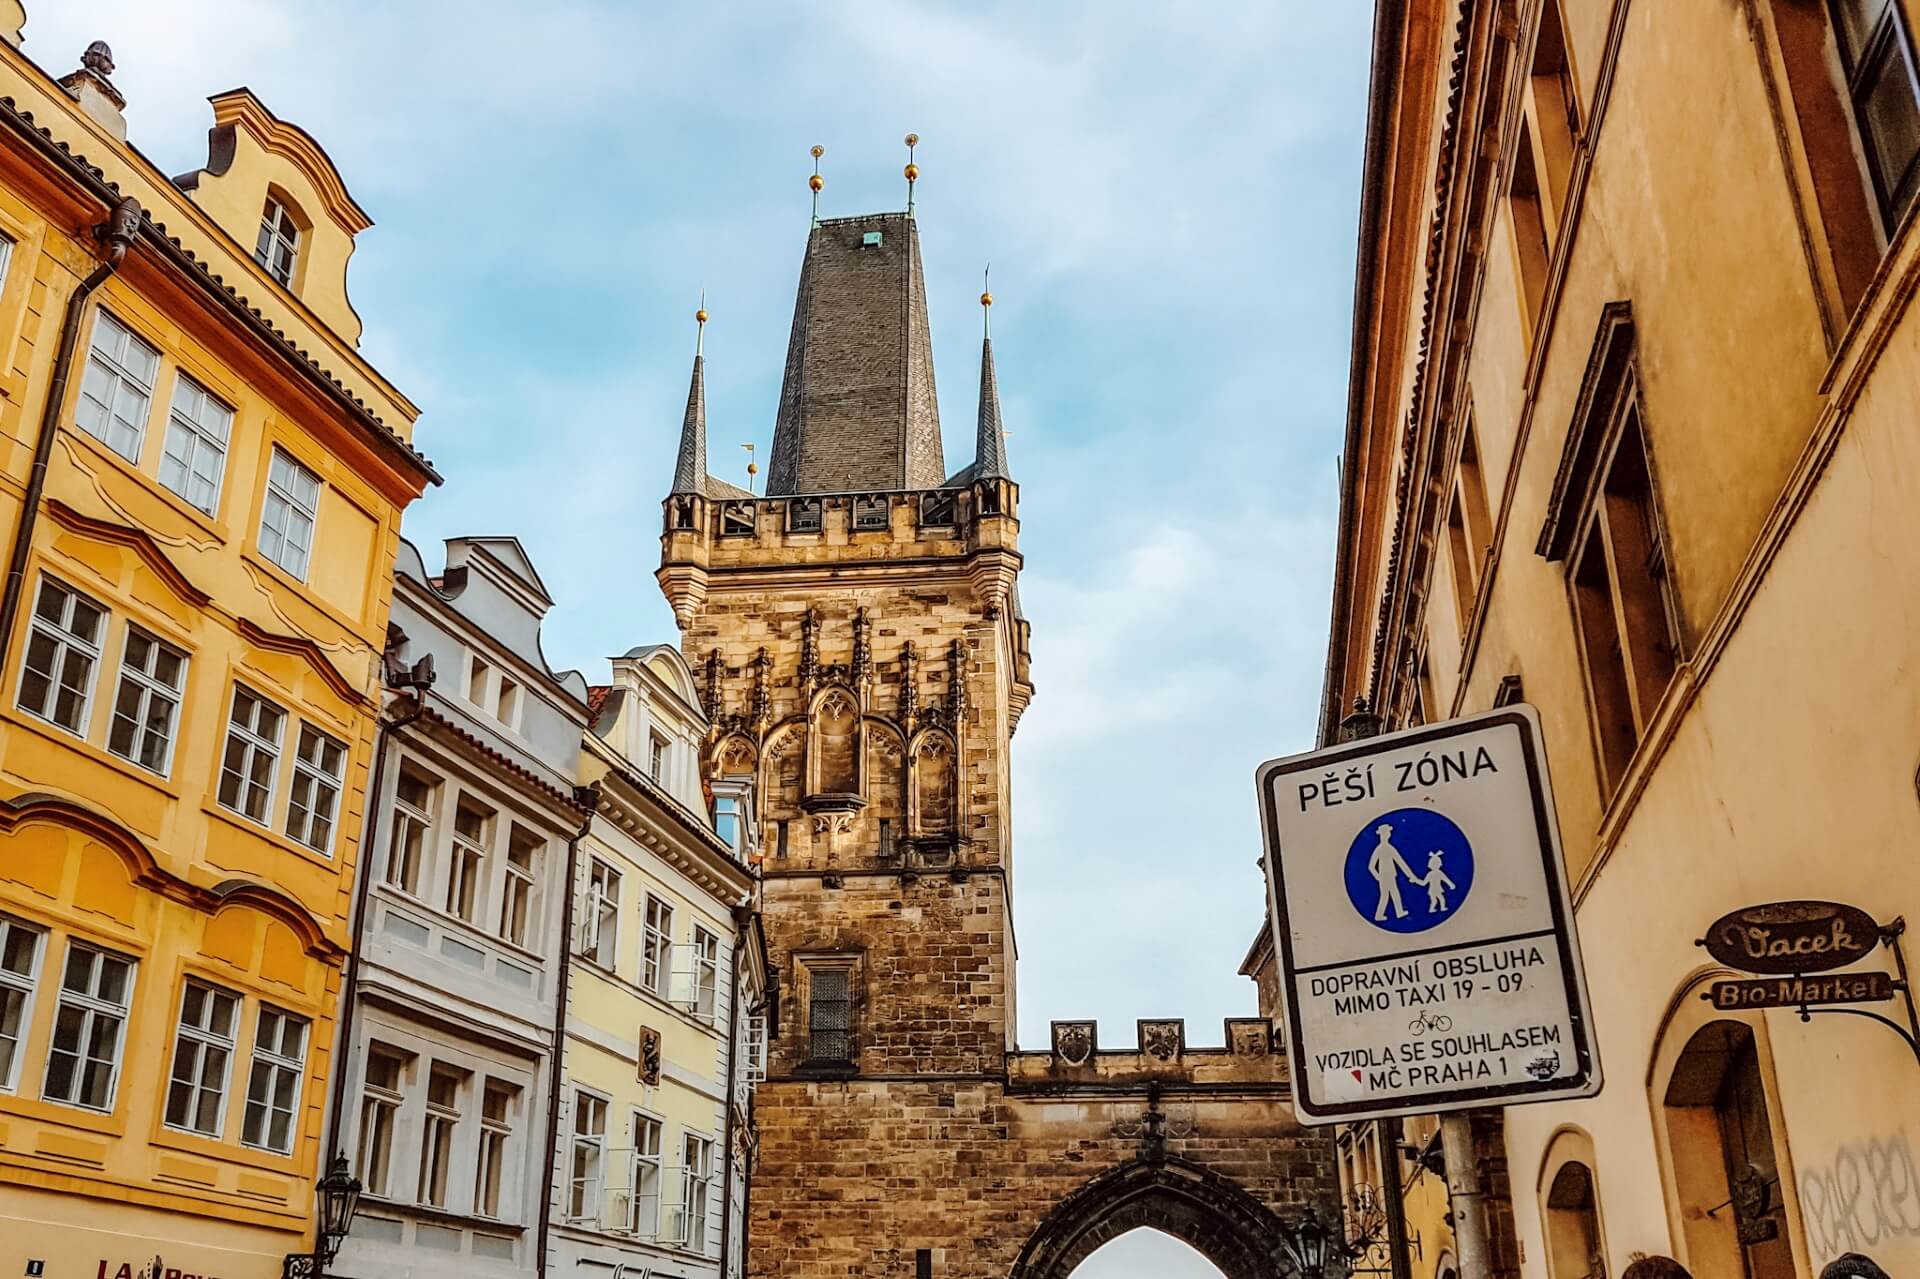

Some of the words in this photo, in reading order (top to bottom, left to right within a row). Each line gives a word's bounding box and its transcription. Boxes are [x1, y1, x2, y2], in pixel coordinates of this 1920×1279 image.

[1298, 763, 1376, 812] PĚŠÍ
[1394, 746, 1499, 792] ZÓNA
[1720, 918, 1863, 958] Vacek
[1311, 959, 1421, 997] DOPRAVNÍ
[1432, 947, 1545, 980] OBSLUHA
[1334, 992, 1390, 1016] MIMO
[1395, 983, 1446, 1008] TAXI
[1453, 979, 1474, 1000] 19
[1497, 972, 1524, 994] 09
[1719, 976, 1880, 1005] Bio-Market
[1315, 1046, 1396, 1073] VOZIDLA
[1400, 1041, 1426, 1063] SE
[1431, 1024, 1561, 1059] SOUHLASEM
[1369, 1066, 1402, 1092] MČ
[1408, 1058, 1492, 1087] PRAHA
[1499, 1057, 1508, 1076] 1
